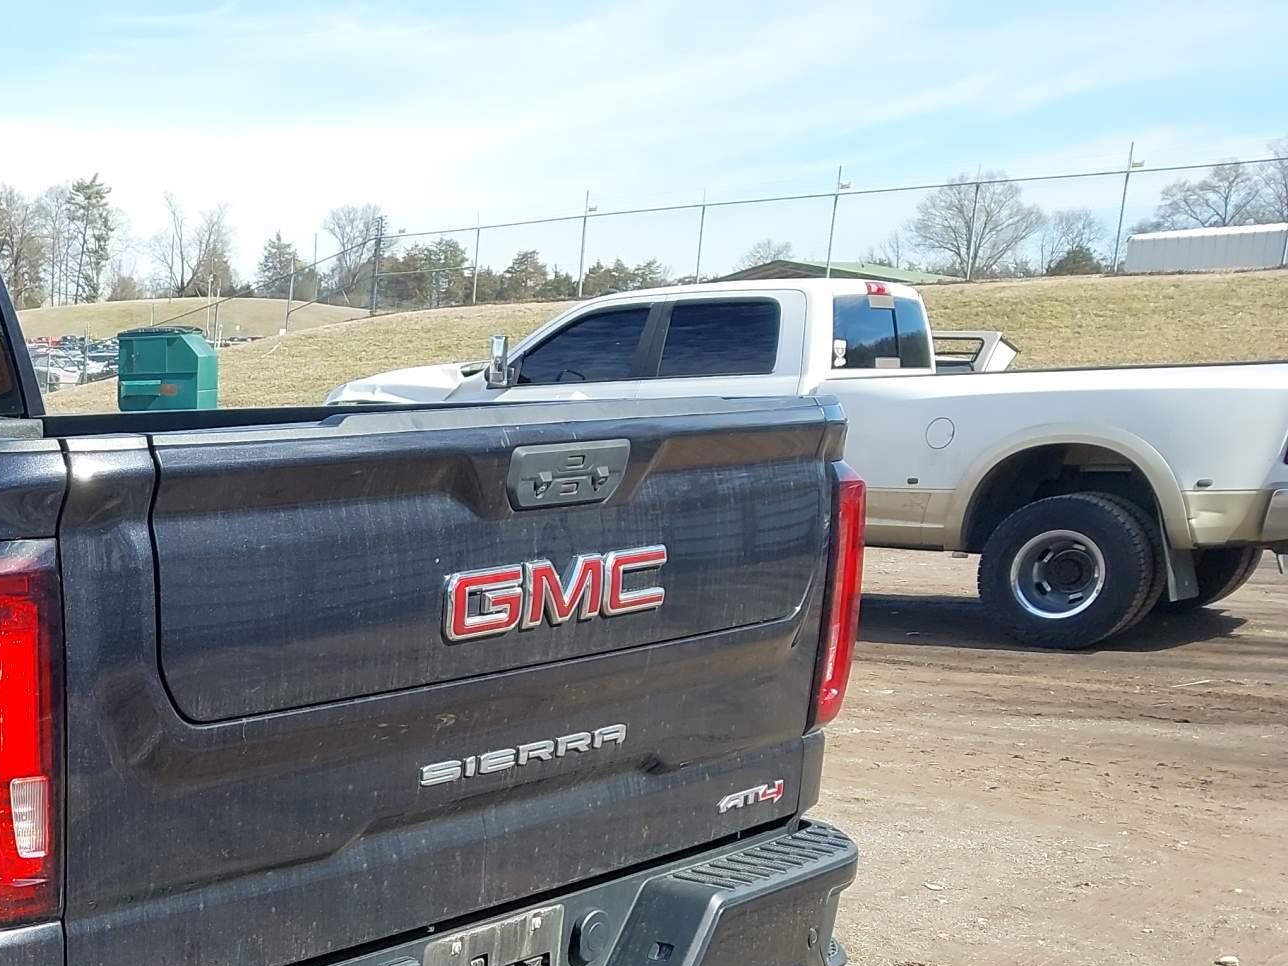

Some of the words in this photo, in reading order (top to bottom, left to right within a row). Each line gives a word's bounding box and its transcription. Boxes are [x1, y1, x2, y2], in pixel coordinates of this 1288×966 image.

[444, 544, 667, 642] GMC
[420, 723, 627, 787] SIERRA
[716, 779, 785, 814] AT4
